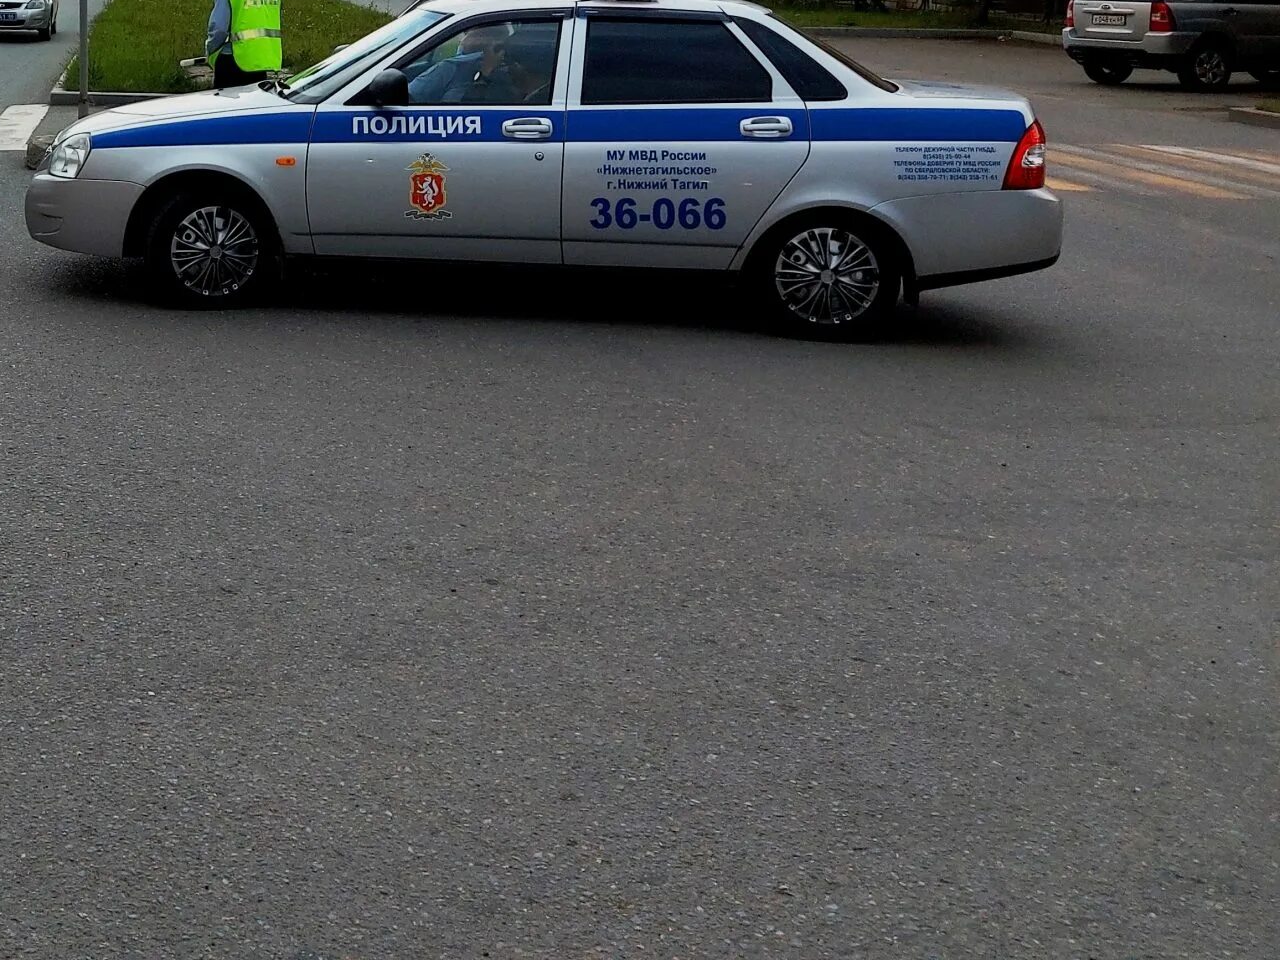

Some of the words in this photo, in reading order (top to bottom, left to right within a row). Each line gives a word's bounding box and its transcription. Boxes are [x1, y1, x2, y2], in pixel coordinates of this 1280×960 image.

[352, 116, 482, 138] ПОЛИЦИЯ
[606, 150, 625, 161] МУ
[628, 150, 658, 163] МВД
[661, 150, 706, 161] России
[597, 164, 717, 176] «Нижнетагильское»
[670, 178, 708, 190] Тагил
[589, 197, 727, 230] 36-066
